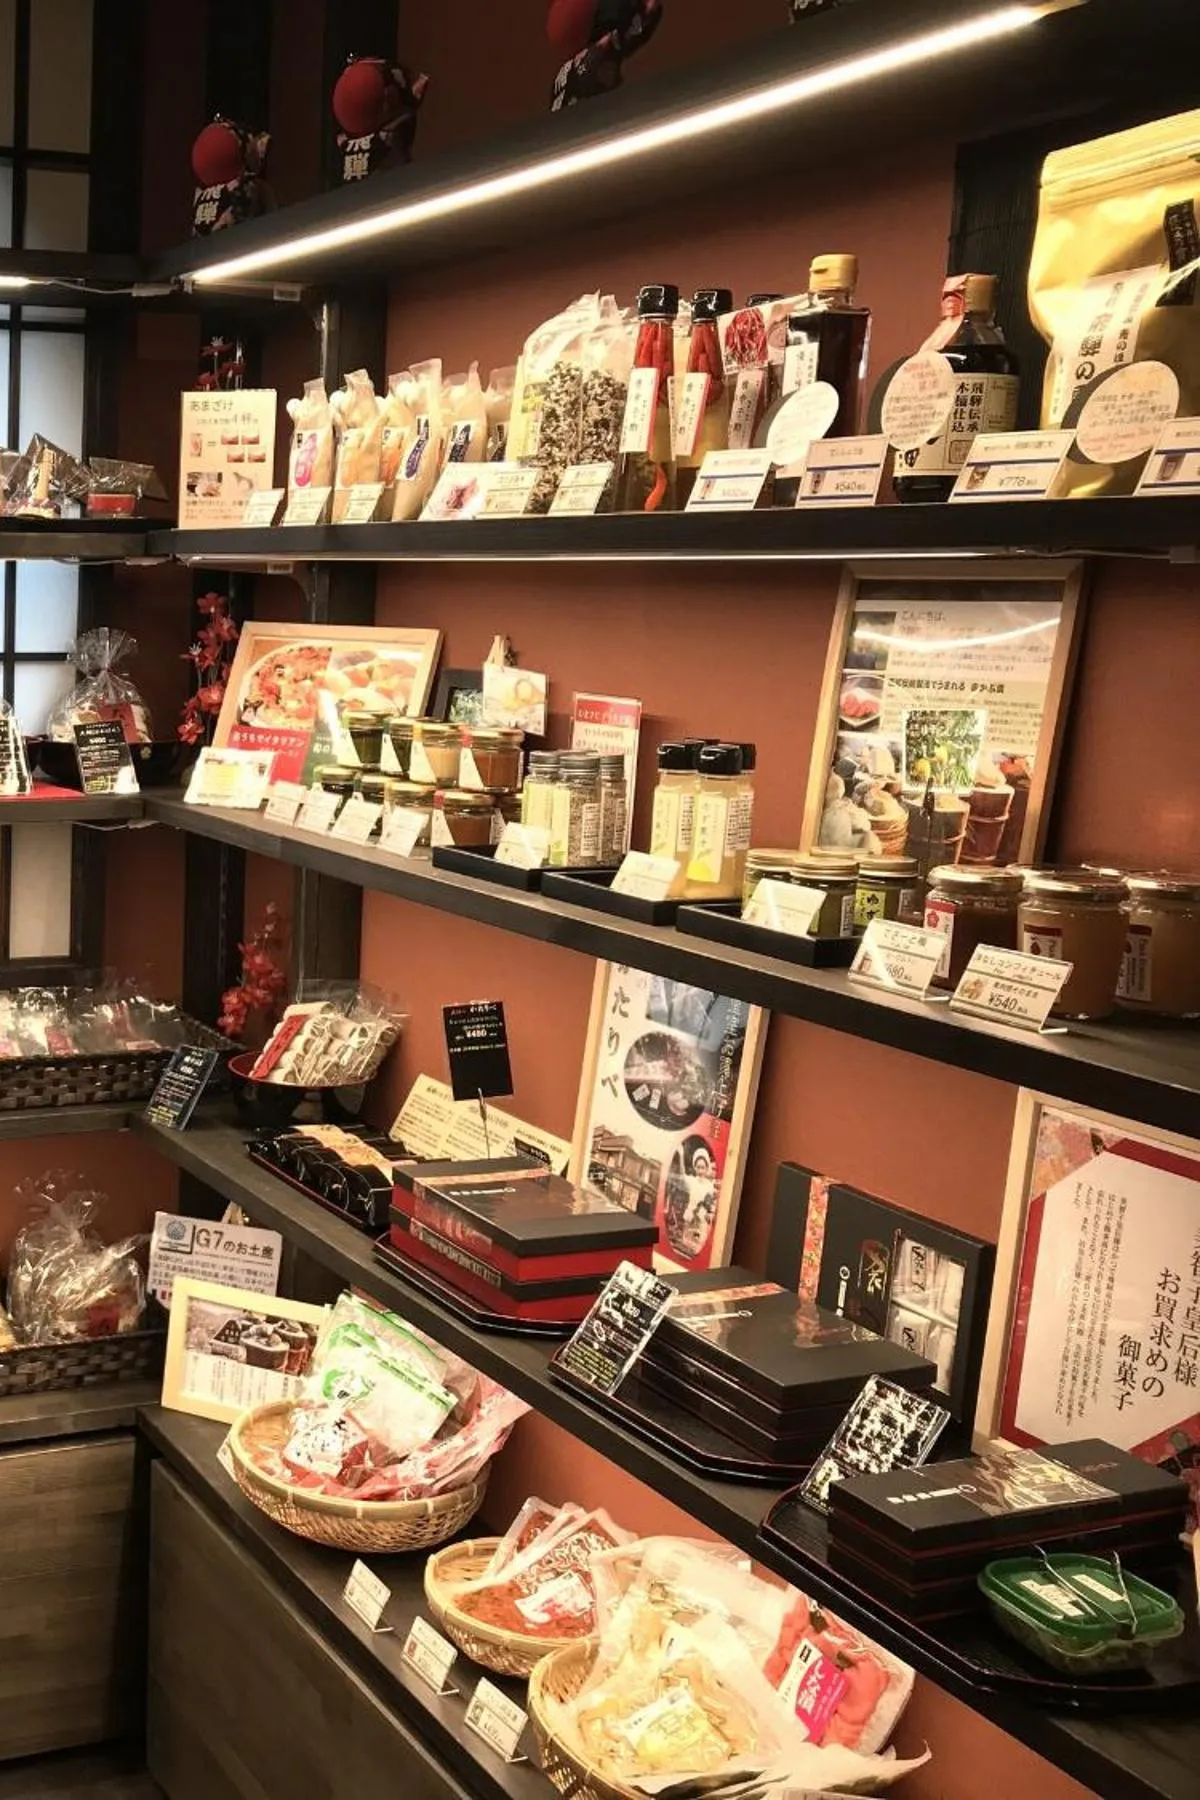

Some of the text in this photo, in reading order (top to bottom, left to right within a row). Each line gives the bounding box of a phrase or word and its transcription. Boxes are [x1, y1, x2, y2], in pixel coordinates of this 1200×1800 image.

[987, 991, 1018, 1011] ¥540
[196, 1228, 274, 1260] G7のお土産
[1142, 1267, 1181, 1398] お買求めの
[1111, 1333, 1142, 1412] 御菓子
